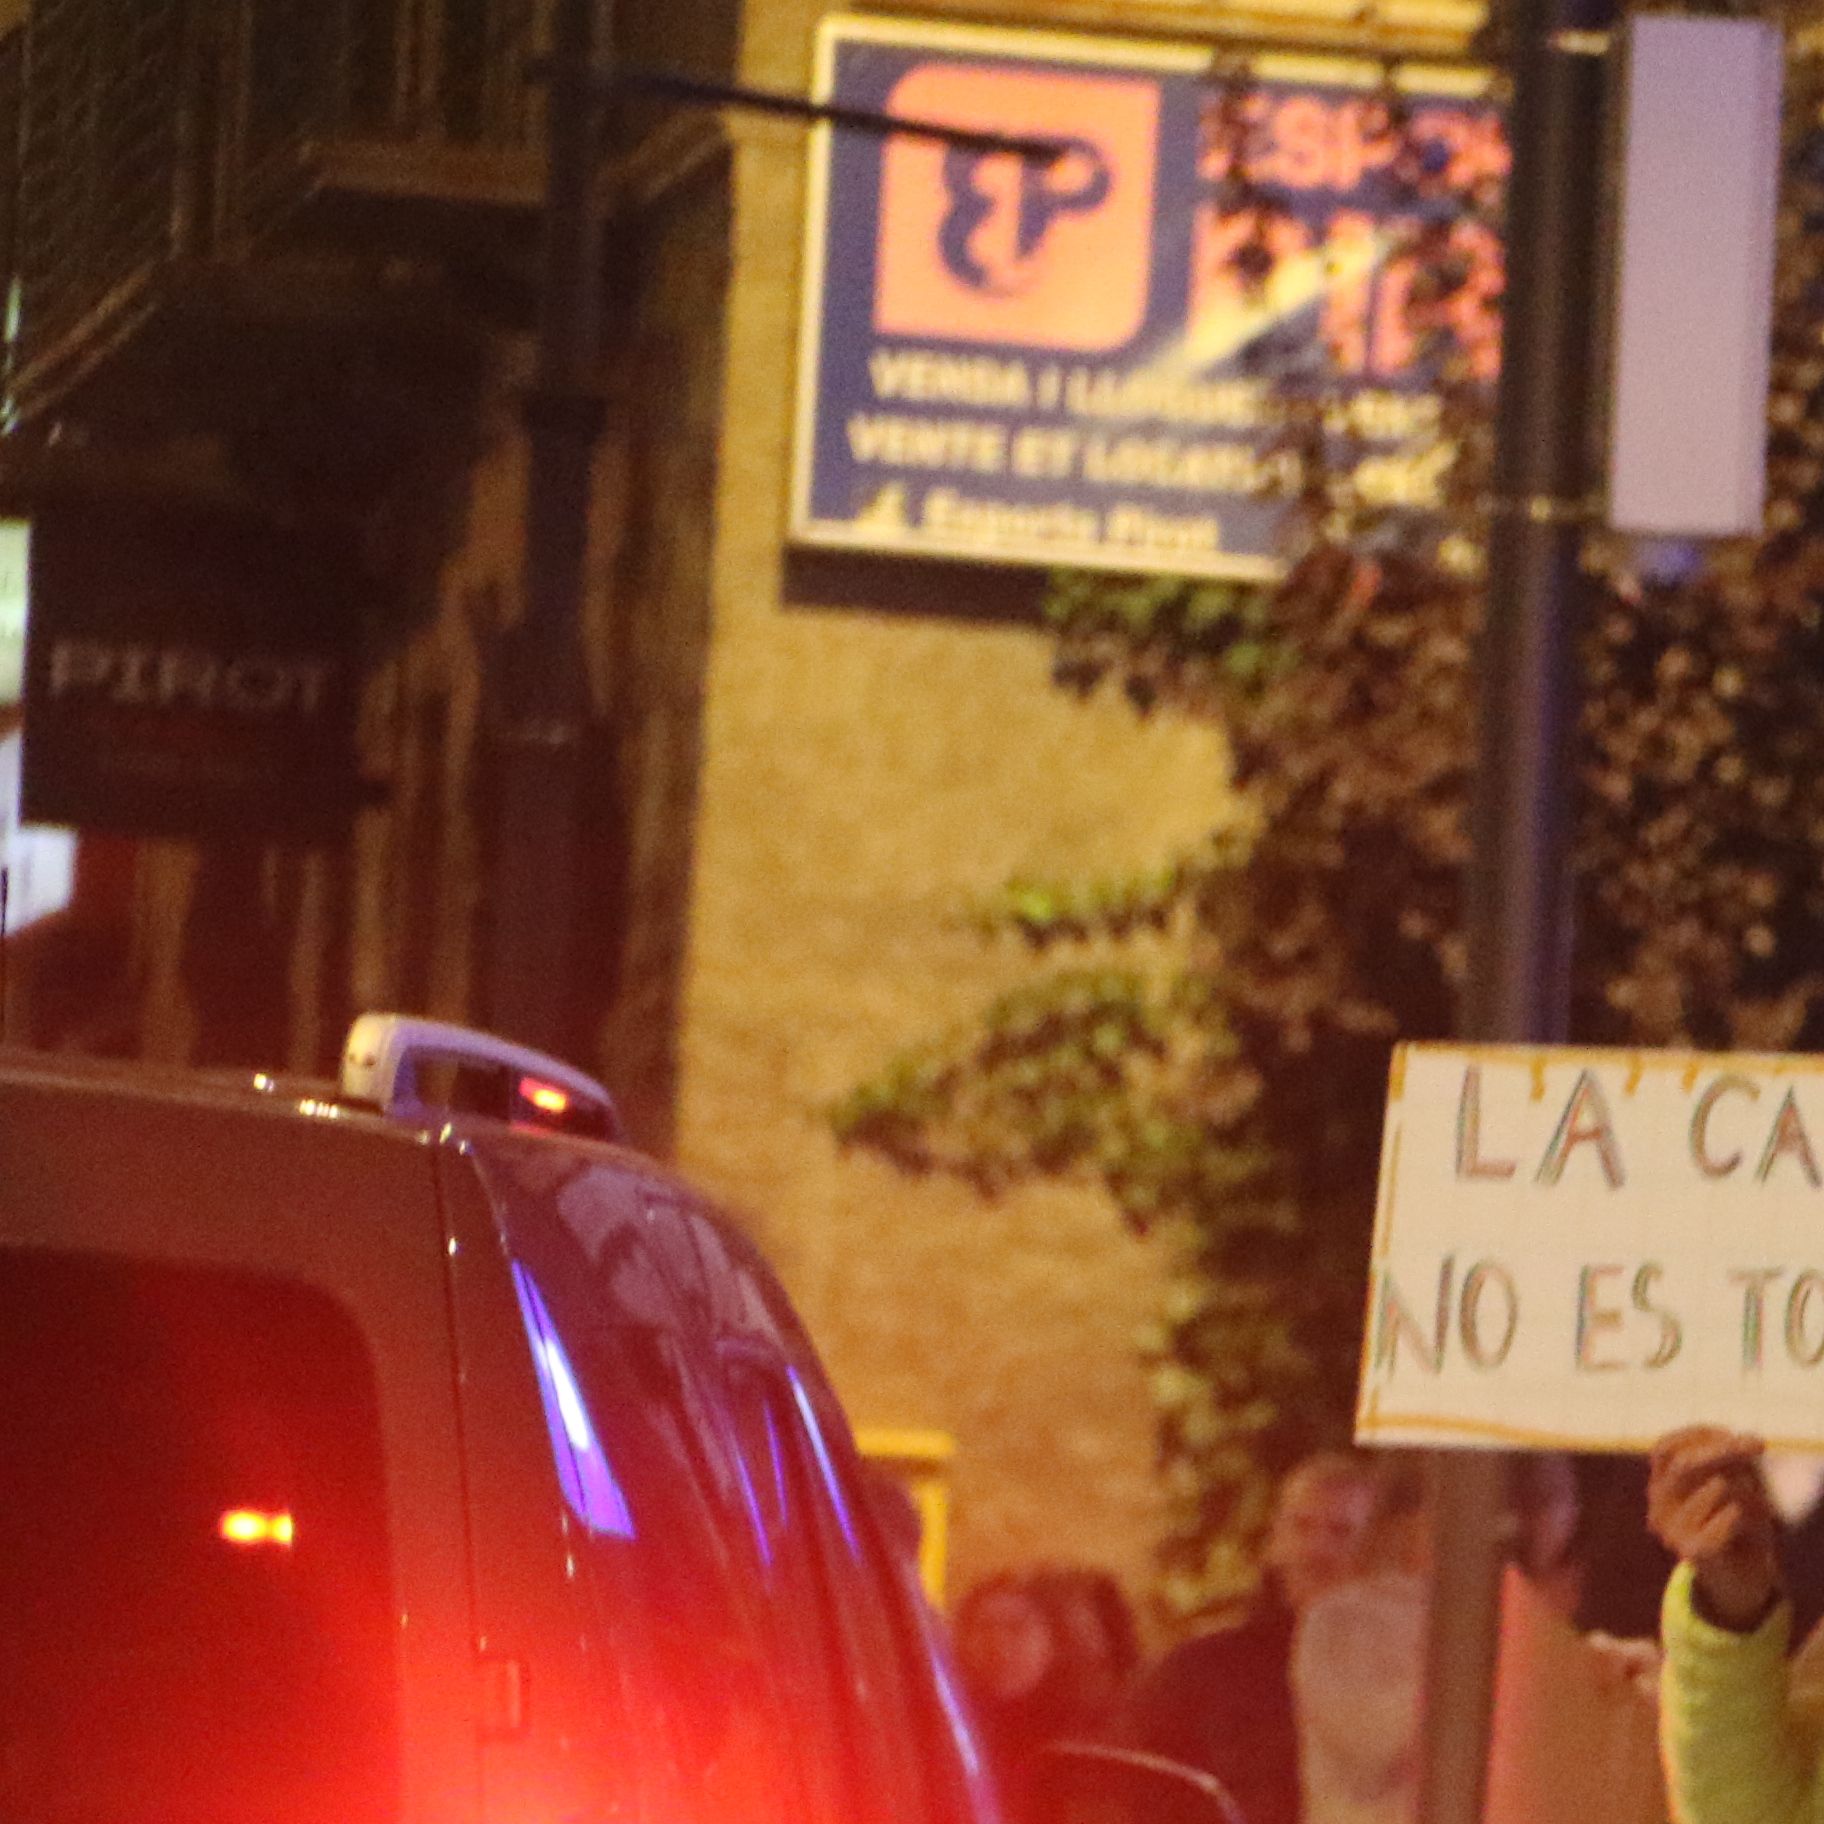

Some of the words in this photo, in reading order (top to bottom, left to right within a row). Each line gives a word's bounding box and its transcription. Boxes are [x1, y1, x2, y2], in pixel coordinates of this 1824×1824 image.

[1455, 1065, 1627, 1189] LA
[1374, 1253, 1520, 1388] NO
[1574, 1262, 1685, 1372] ES
